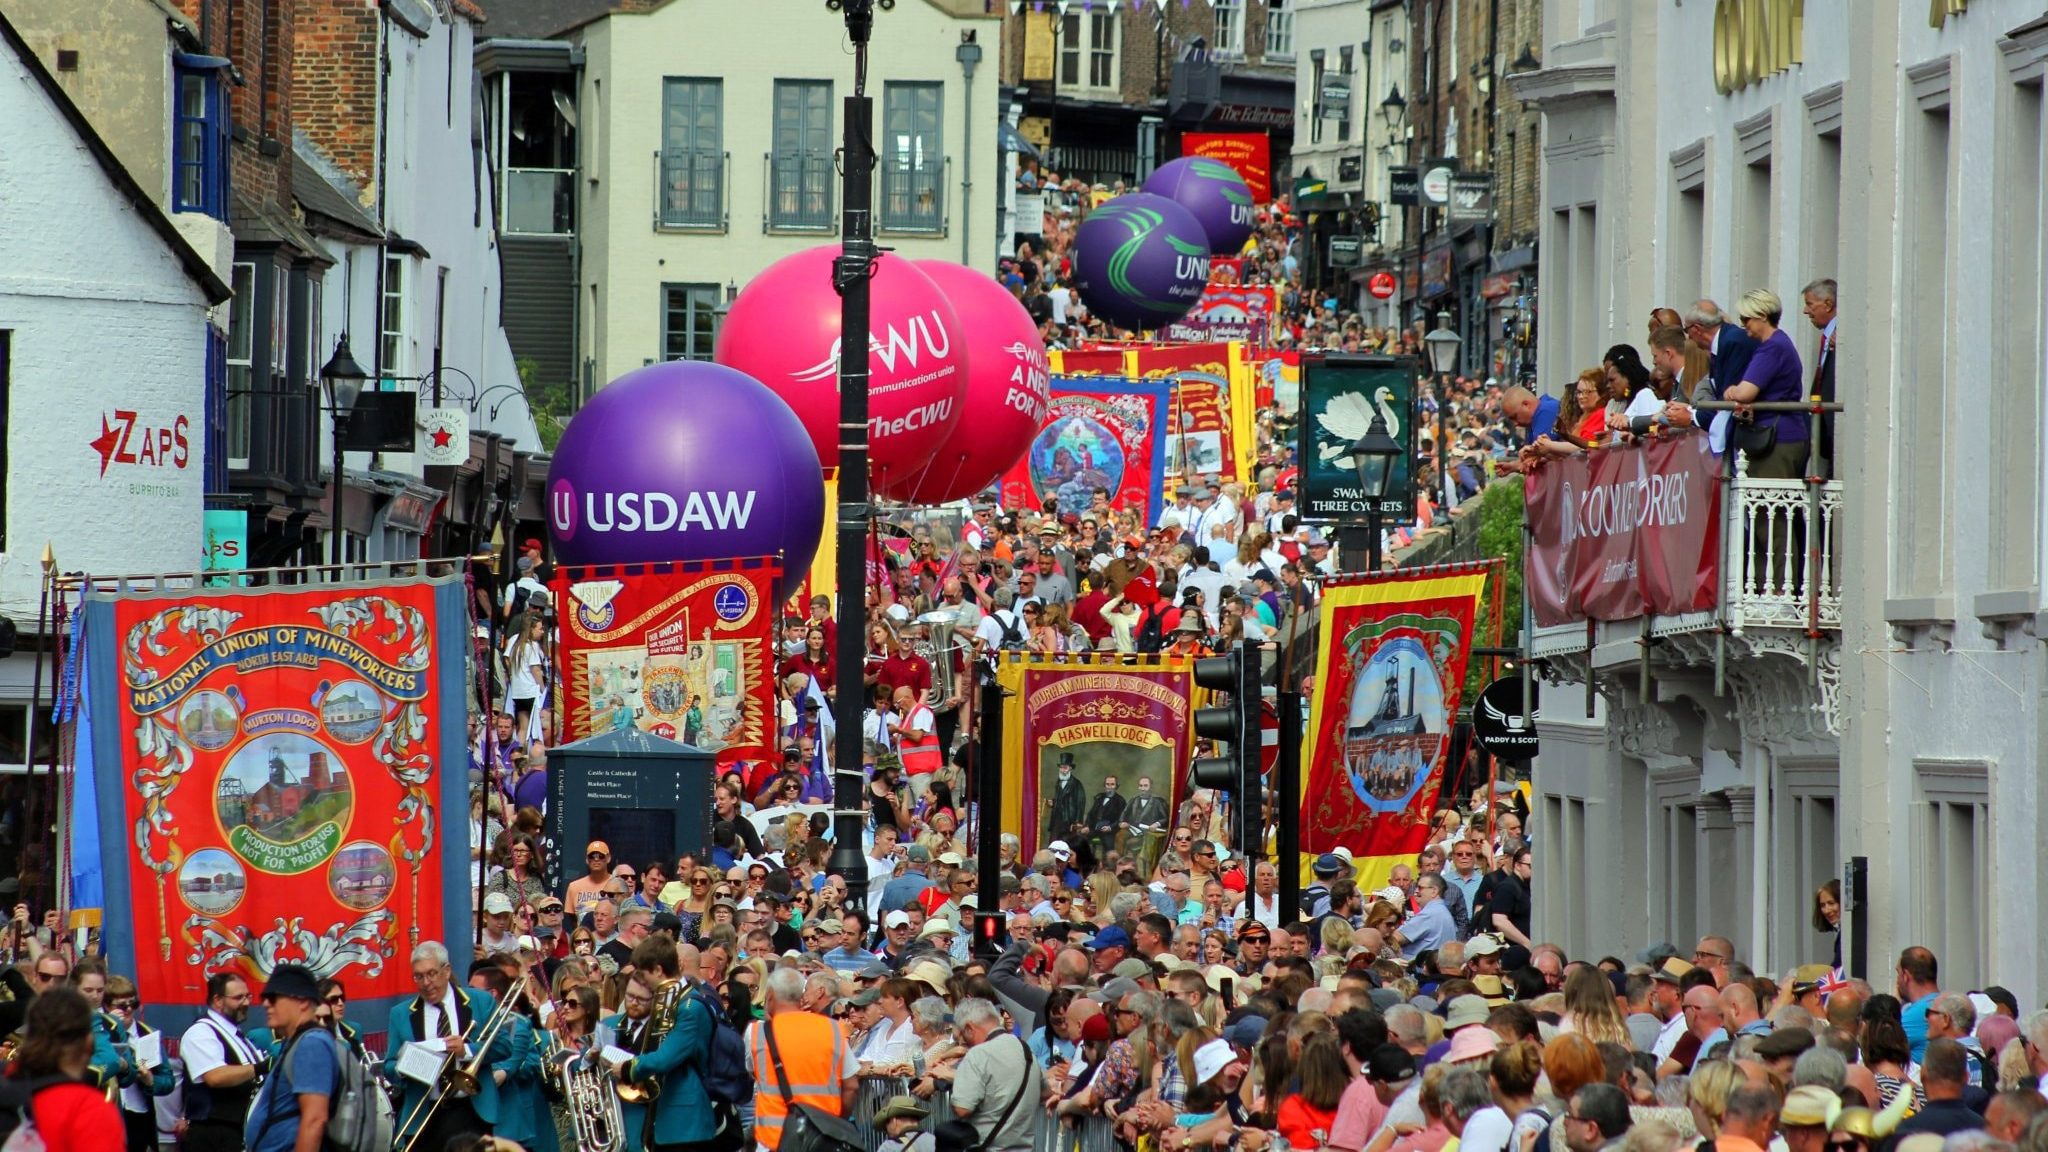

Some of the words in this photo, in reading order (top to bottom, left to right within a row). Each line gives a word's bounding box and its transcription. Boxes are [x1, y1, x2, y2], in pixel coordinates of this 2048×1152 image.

[1220, 104, 1240, 121] The
[868, 371, 937, 396] ommunications
[937, 364, 955, 378] union
[1010, 364, 1024, 386] A
[1005, 387, 1034, 417] FOR
[114, 408, 189, 469] ZAPS
[129, 483, 165, 497] BURRITO
[1635, 470, 1689, 529] ORKERS
[554, 491, 571, 531] U
[586, 490, 758, 532] USDAW
[1311, 500, 1349, 512] THREE
[202, 541, 239, 557] APS
[692, 575, 725, 593] ALLIED
[648, 632, 658, 642] OUR
[658, 619, 683, 638] UNION
[659, 634, 684, 647] SECURITY
[660, 644, 684, 653] FUTURE
[134, 651, 210, 706] NATIONAL
[214, 630, 270, 658] UNION
[275, 628, 299, 645] OF
[304, 629, 417, 692] MINEWORKERS
[236, 652, 270, 670] NORTH
[272, 651, 294, 663] EAST
[295, 652, 319, 667] AREA
[1032, 681, 1073, 708] DURHAM
[1072, 675, 1112, 691] MINERS
[243, 712, 285, 731] MURTON
[287, 712, 318, 730] LODGE
[1058, 725, 1114, 745] HASWELL
[1114, 726, 1151, 744] LODGE
[1485, 736, 1510, 744] PADDY
[557, 800, 565, 834] BRIDGE
[241, 828, 299, 858] PRODUCTION
[299, 836, 320, 853] FOR
[319, 824, 336, 842] USE
[240, 843, 261, 862] NOT
[263, 855, 285, 870] FOR
[290, 844, 328, 868] PROFIT
